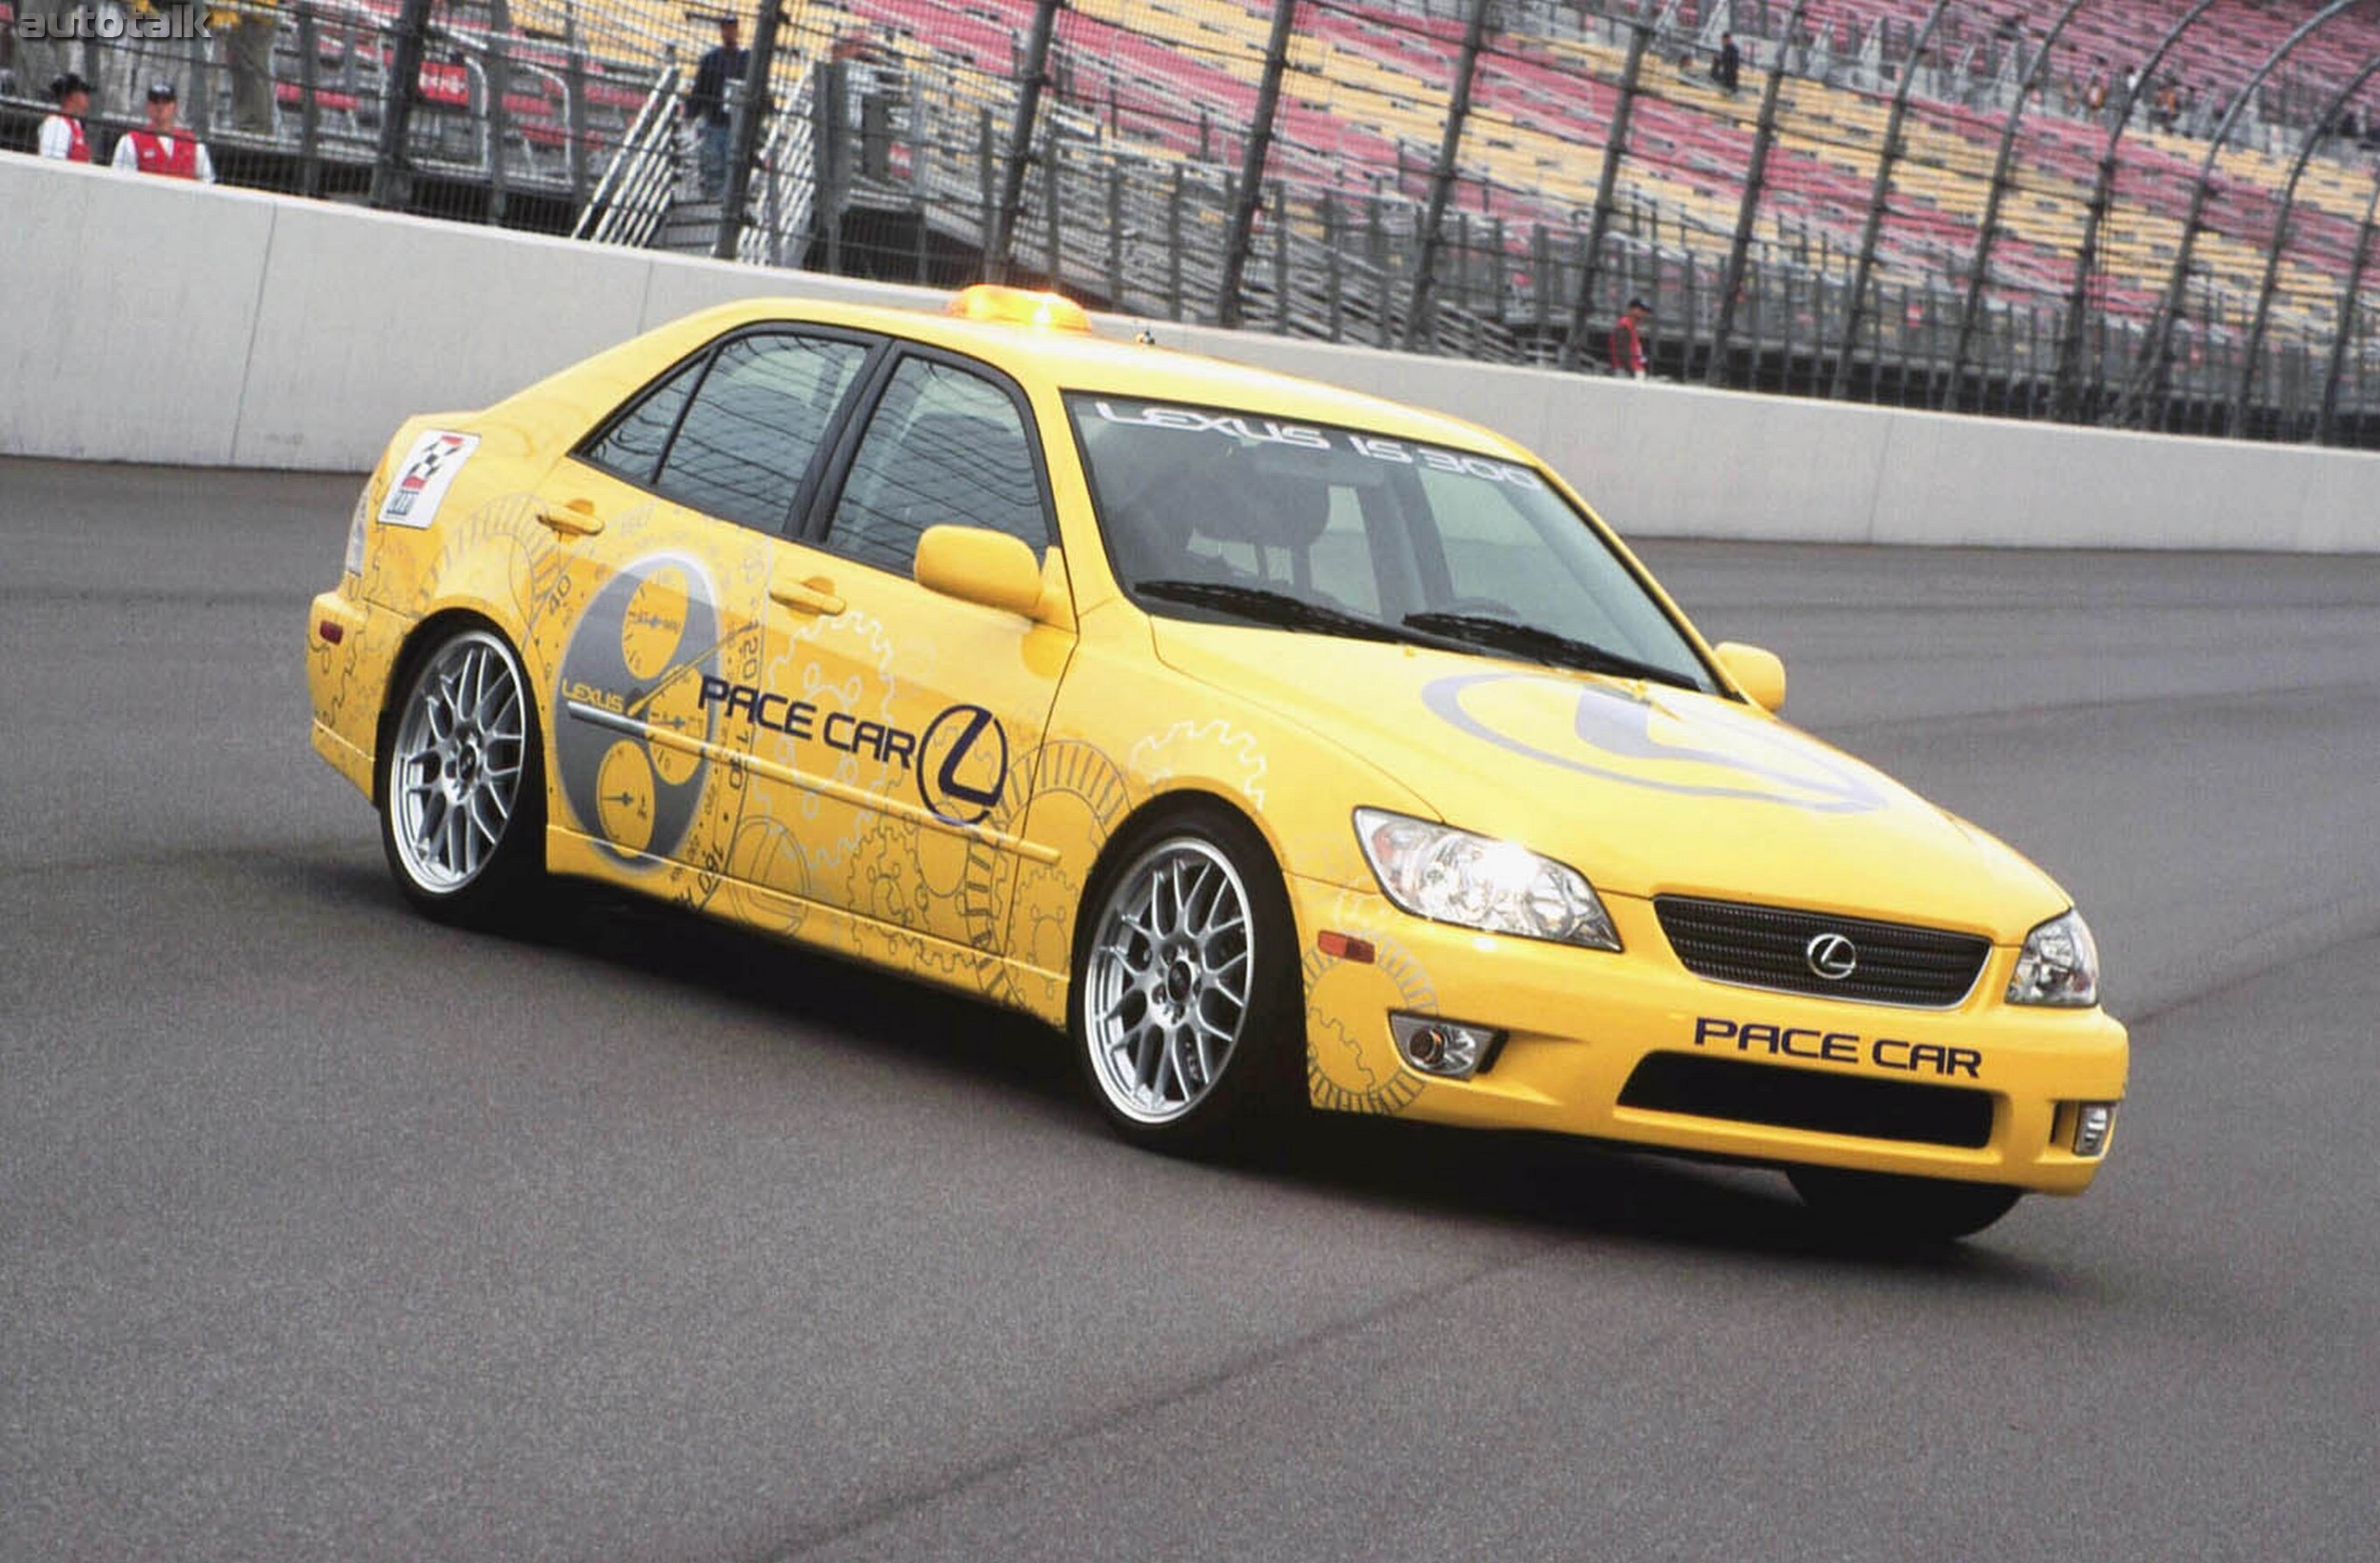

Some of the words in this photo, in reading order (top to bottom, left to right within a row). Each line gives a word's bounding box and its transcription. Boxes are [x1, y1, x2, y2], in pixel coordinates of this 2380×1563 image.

[1095, 401, 1332, 450] LEXUS
[1349, 434, 1415, 465] IS
[1417, 447, 1541, 489] 300
[562, 678, 625, 713] LEXUS
[698, 674, 817, 741] PACE
[823, 712, 916, 769] CAR
[1694, 1017, 1860, 1063] PACE
[1871, 1039, 1982, 1078] CAR
